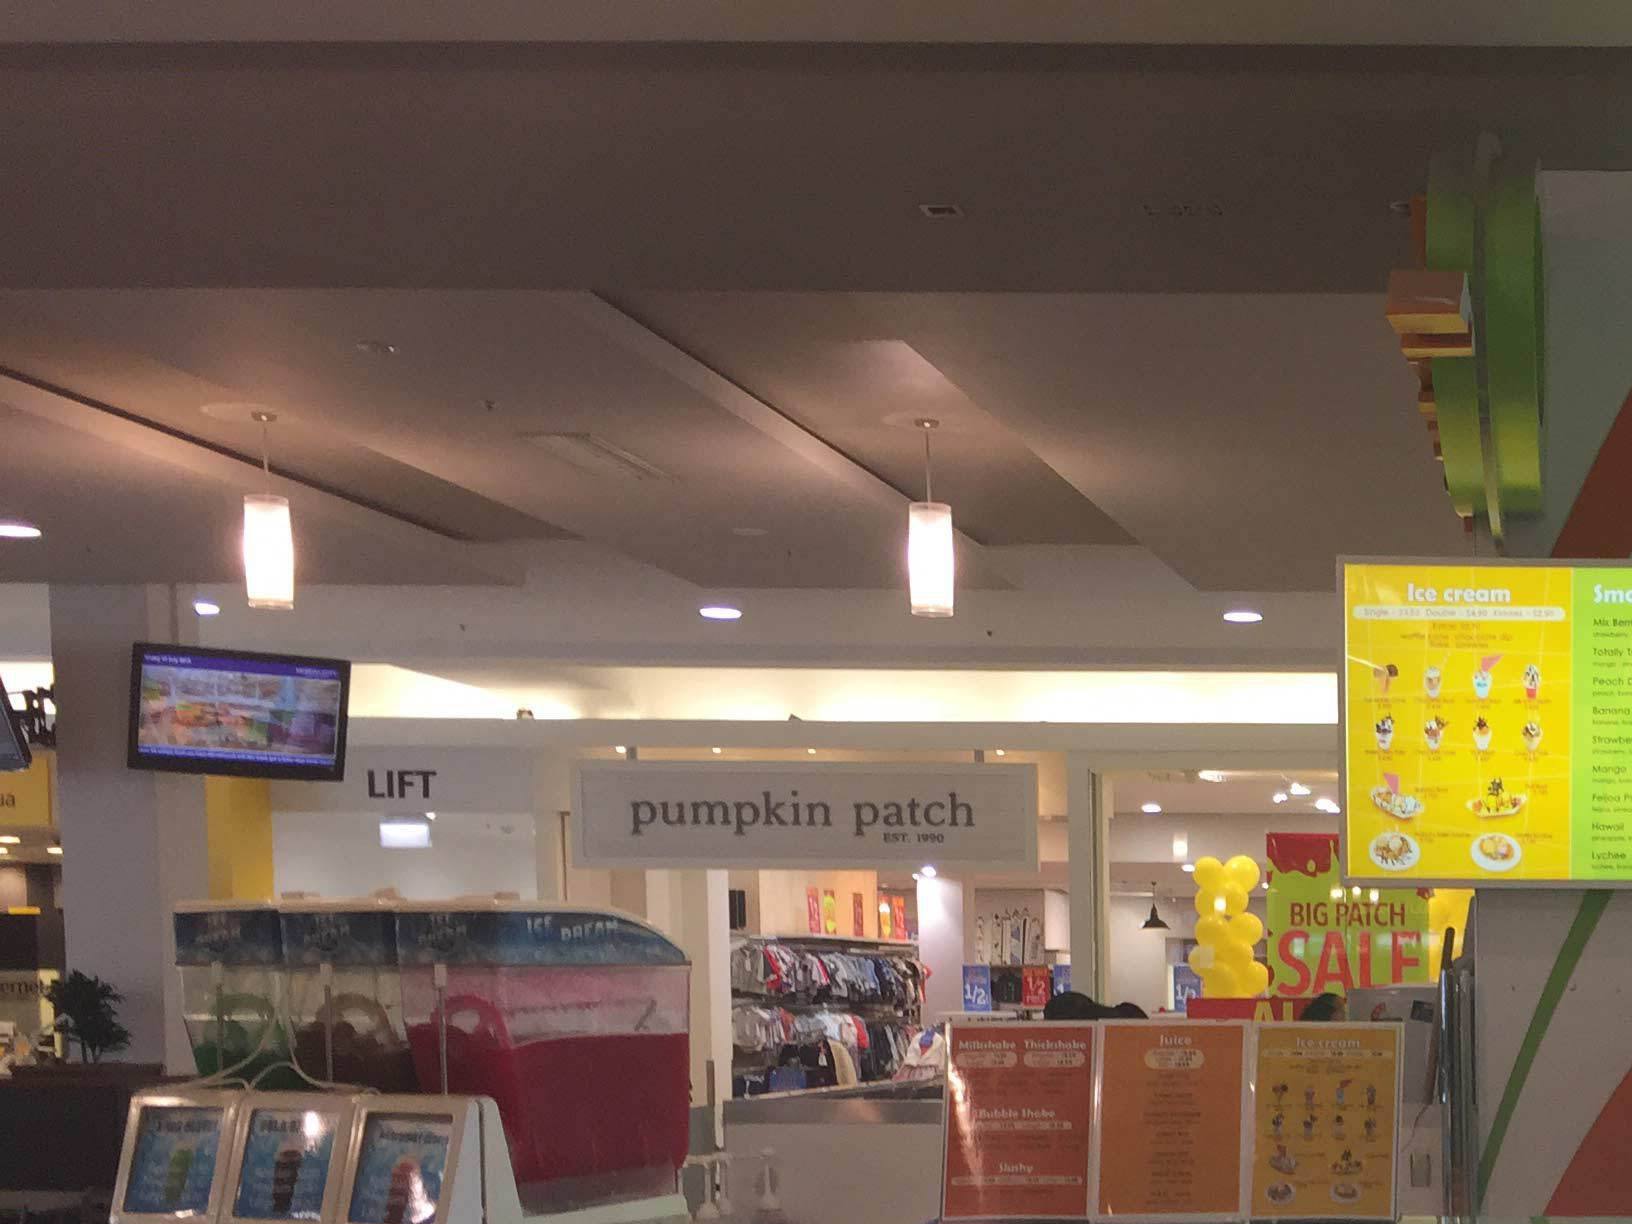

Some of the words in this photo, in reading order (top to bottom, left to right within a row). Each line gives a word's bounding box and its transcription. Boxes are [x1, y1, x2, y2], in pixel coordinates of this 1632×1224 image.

[1407, 583, 1437, 602] Ice
[1443, 587, 1511, 602] cream
[1592, 618, 1609, 628] Mix
[1592, 648, 1623, 658] Totally
[1592, 677, 1624, 688] Peach
[1592, 706, 1631, 715] Banana
[1592, 765, 1627, 775] Mango
[368, 770, 437, 799] LIFT
[631, 790, 832, 836] pumpkin
[853, 791, 976, 836] patch
[1591, 822, 1625, 831] Hawaii
[882, 833, 911, 844] EST.
[916, 833, 945, 844] 1990
[1591, 851, 1627, 861] Lychee
[1289, 902, 1329, 926] BIG
[1335, 902, 1406, 927] PATCH
[1277, 930, 1422, 997] SALE
[958, 1040, 1017, 1050] Milkshake
[1024, 1040, 1087, 1050] Thickshake
[1159, 1034, 1192, 1046] Juice
[1296, 1037, 1317, 1049] Ice
[1319, 1038, 1361, 1049] cream
[977, 1108, 1019, 1119] Bubble
